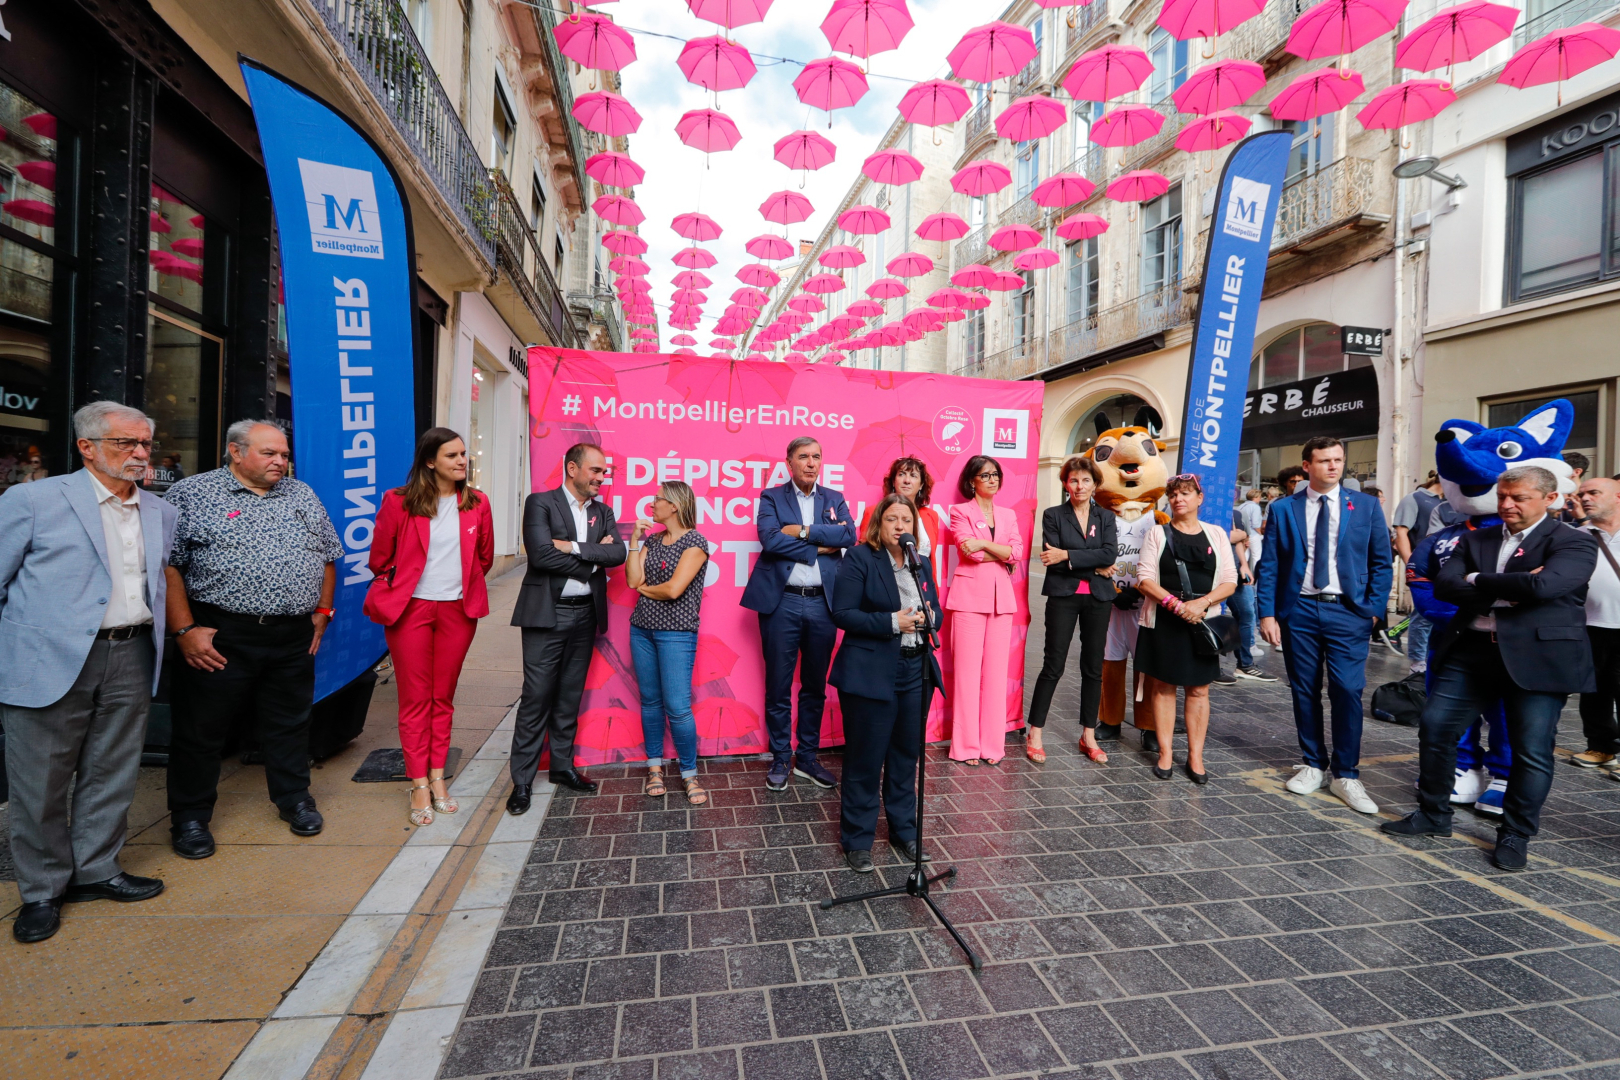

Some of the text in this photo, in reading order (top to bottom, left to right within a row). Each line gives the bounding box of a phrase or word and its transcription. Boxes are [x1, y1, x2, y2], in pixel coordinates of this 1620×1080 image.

[1541, 108, 1620, 157] KOO
[1233, 196, 1258, 224] M
[1226, 223, 1259, 238] Montpellier
[1346, 332, 1382, 347] ERBÉ
[1199, 254, 1246, 468] MONTPELLIER
[593, 396, 855, 430] MontpellierEnRose
[1301, 400, 1364, 418] CHAUSSEUR
[998, 427, 1013, 441] M
[1189, 397, 1205, 463] VILLE DE
[626, 450, 845, 492] DÉPISTAE
[1434, 535, 1460, 555] 34
[1116, 561, 1137, 578] 34
